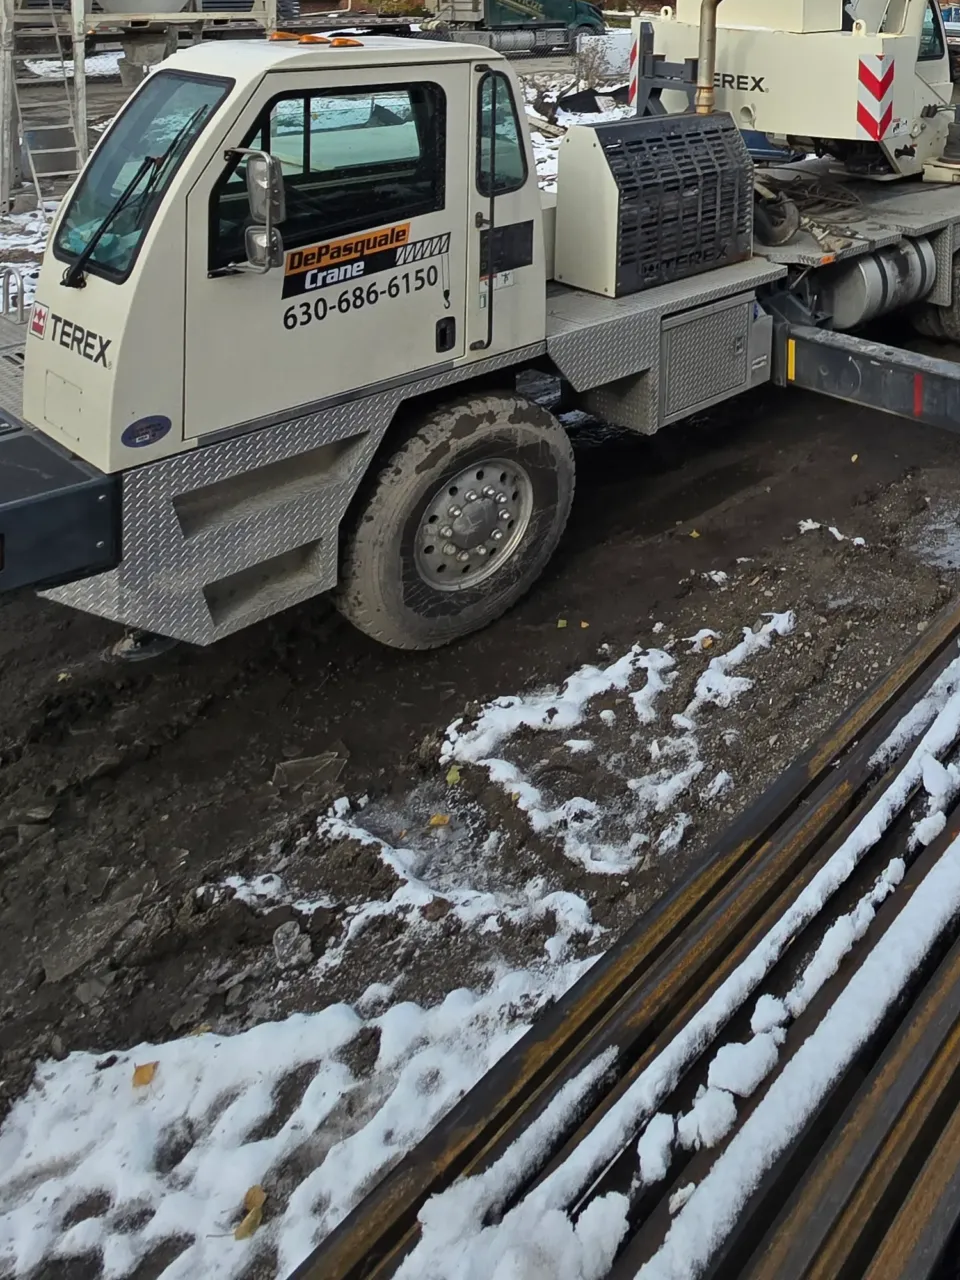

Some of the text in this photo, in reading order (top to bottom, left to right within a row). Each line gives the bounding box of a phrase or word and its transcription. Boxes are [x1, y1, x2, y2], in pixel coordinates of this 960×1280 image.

[713, 72, 765, 93] EREX
[288, 228, 407, 271] DePasquale
[305, 261, 365, 289] Crane
[283, 265, 438, 329] 630-686-6150
[51, 313, 112, 368] TEREX
